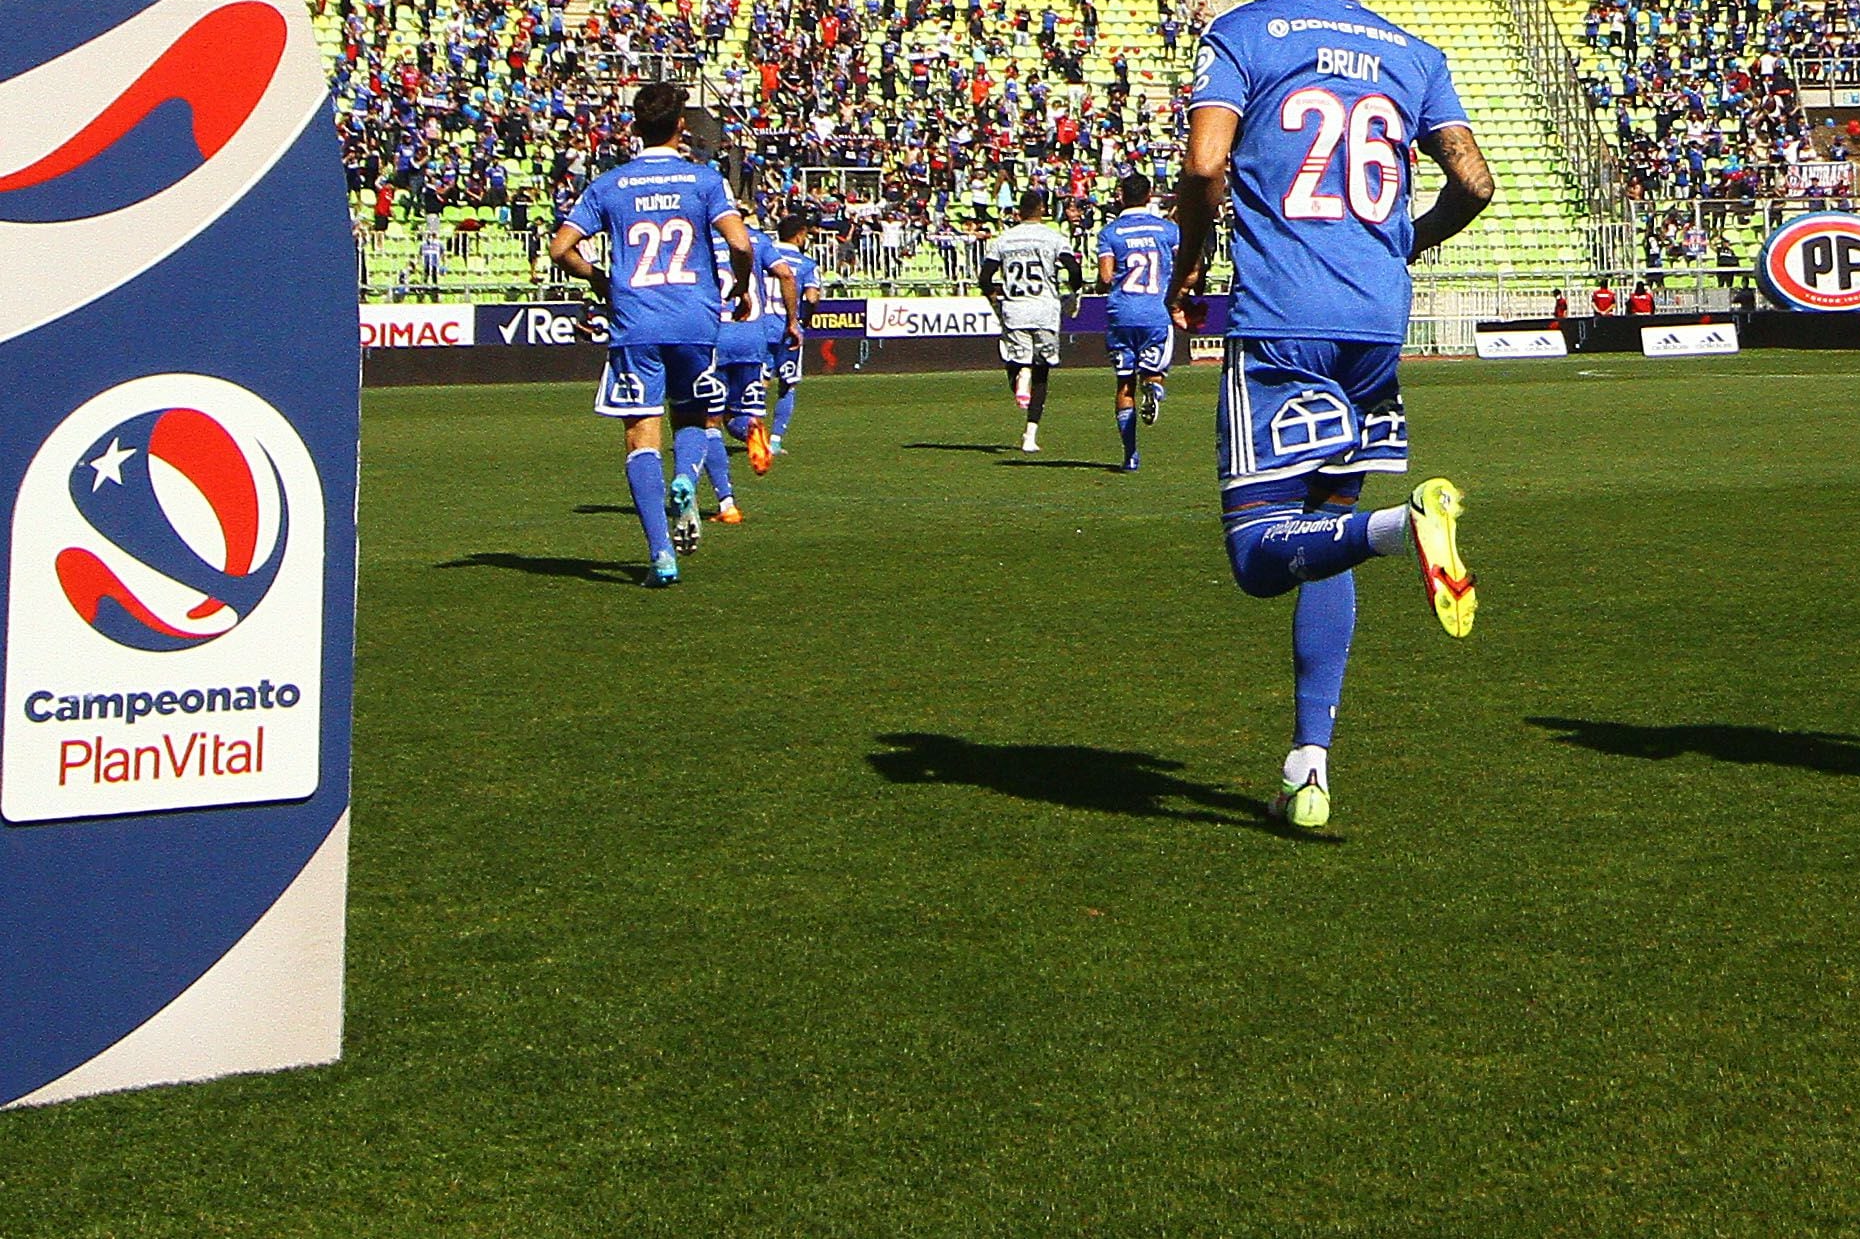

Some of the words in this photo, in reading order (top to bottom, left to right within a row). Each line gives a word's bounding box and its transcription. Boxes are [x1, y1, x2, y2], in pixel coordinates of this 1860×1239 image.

[1291, 19, 1408, 47] DONGFENG
[1317, 48, 1380, 83] BRUN
[1281, 87, 1402, 224] 26
[635, 193, 681, 213] MUÑOZ
[627, 217, 697, 288] 22
[1008, 261, 1043, 297] 25
[1121, 251, 1159, 294] 21
[869, 304, 992, 334] JetSMART
[24, 679, 301, 724] Campeonato
[58, 726, 264, 786] PlanVital
